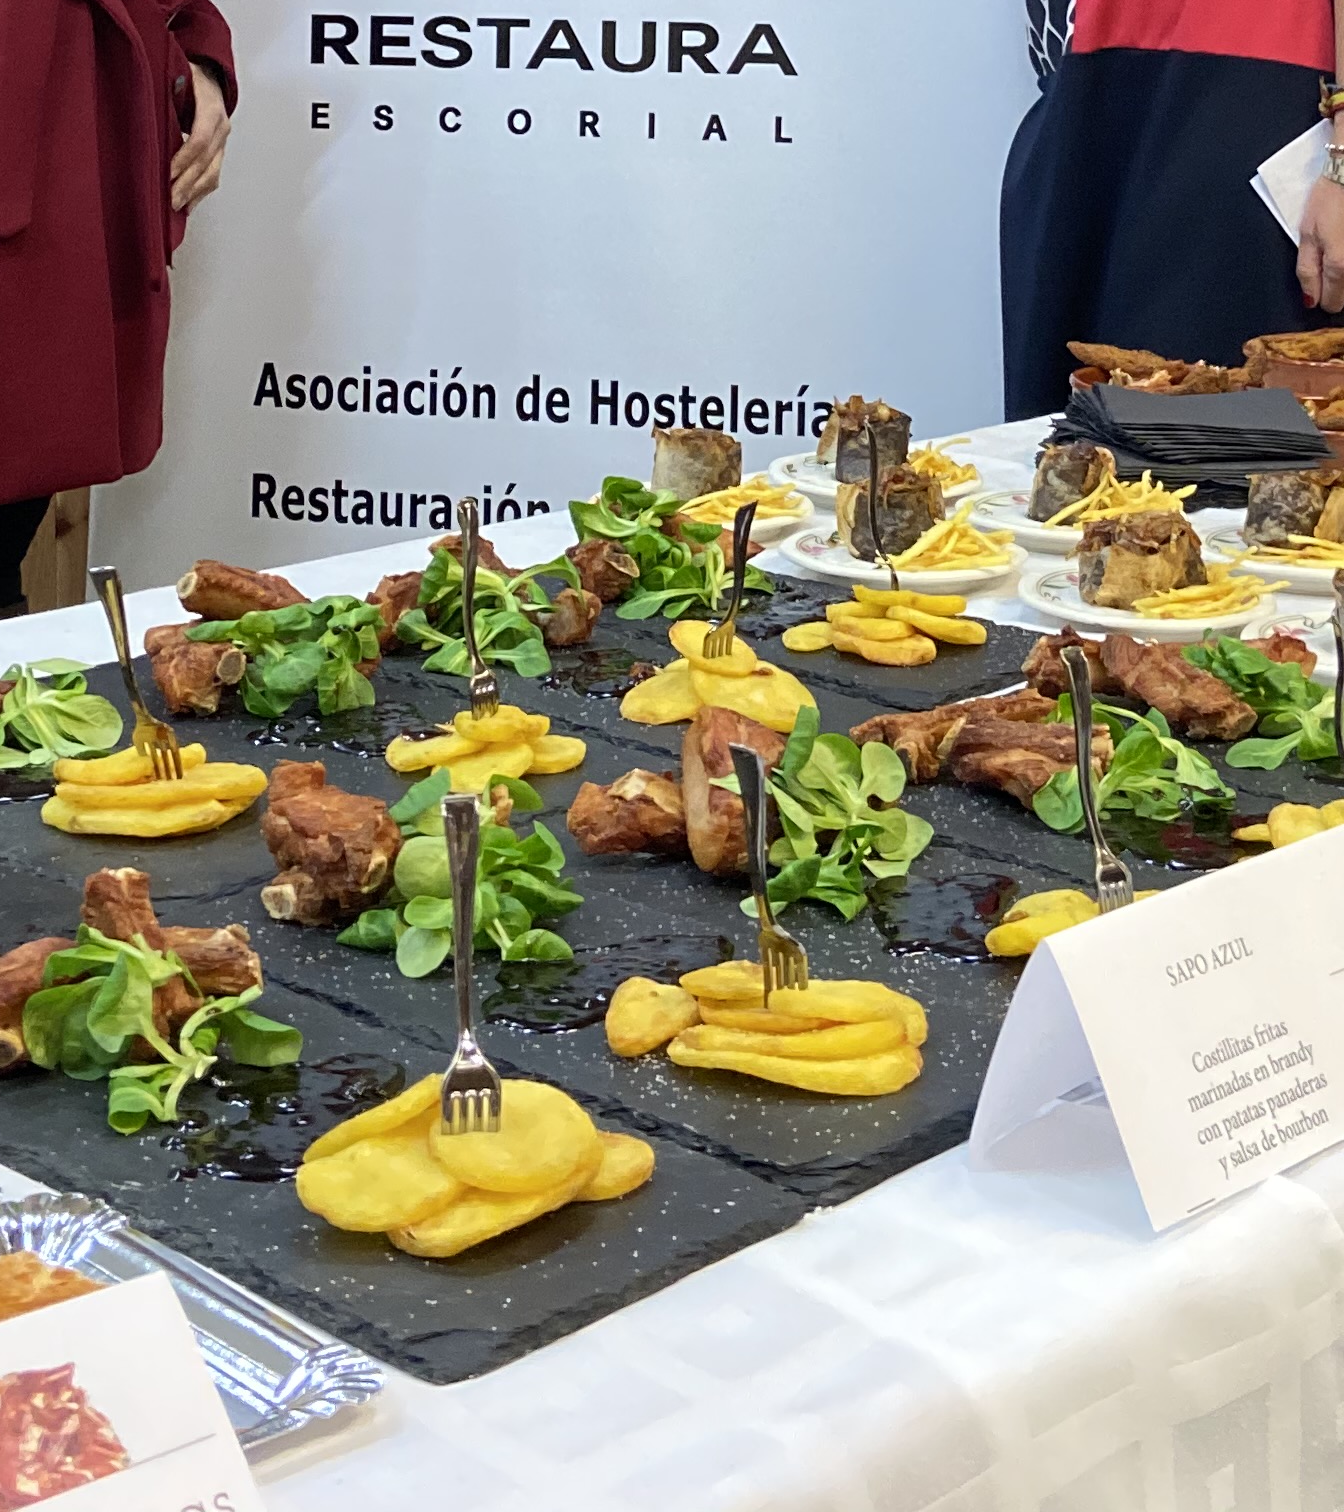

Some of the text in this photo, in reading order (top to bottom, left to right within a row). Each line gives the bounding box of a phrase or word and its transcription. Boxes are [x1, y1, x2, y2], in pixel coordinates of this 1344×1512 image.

[309, 14, 799, 77] RESTAURA
[310, 103, 793, 144] ESCORIAL
[253, 362, 834, 439] Asociación de Hostelería
[251, 472, 551, 530] Restauraión
[1166, 937, 1254, 986] SAPO AZUL
[1187, 1040, 1314, 1113] marinadas en brandy
[1191, 1021, 1289, 1073] Costillitas fritas
[1197, 1073, 1328, 1145] con patatas panaderas
[1218, 1107, 1330, 1180] y salsa de bourbon
